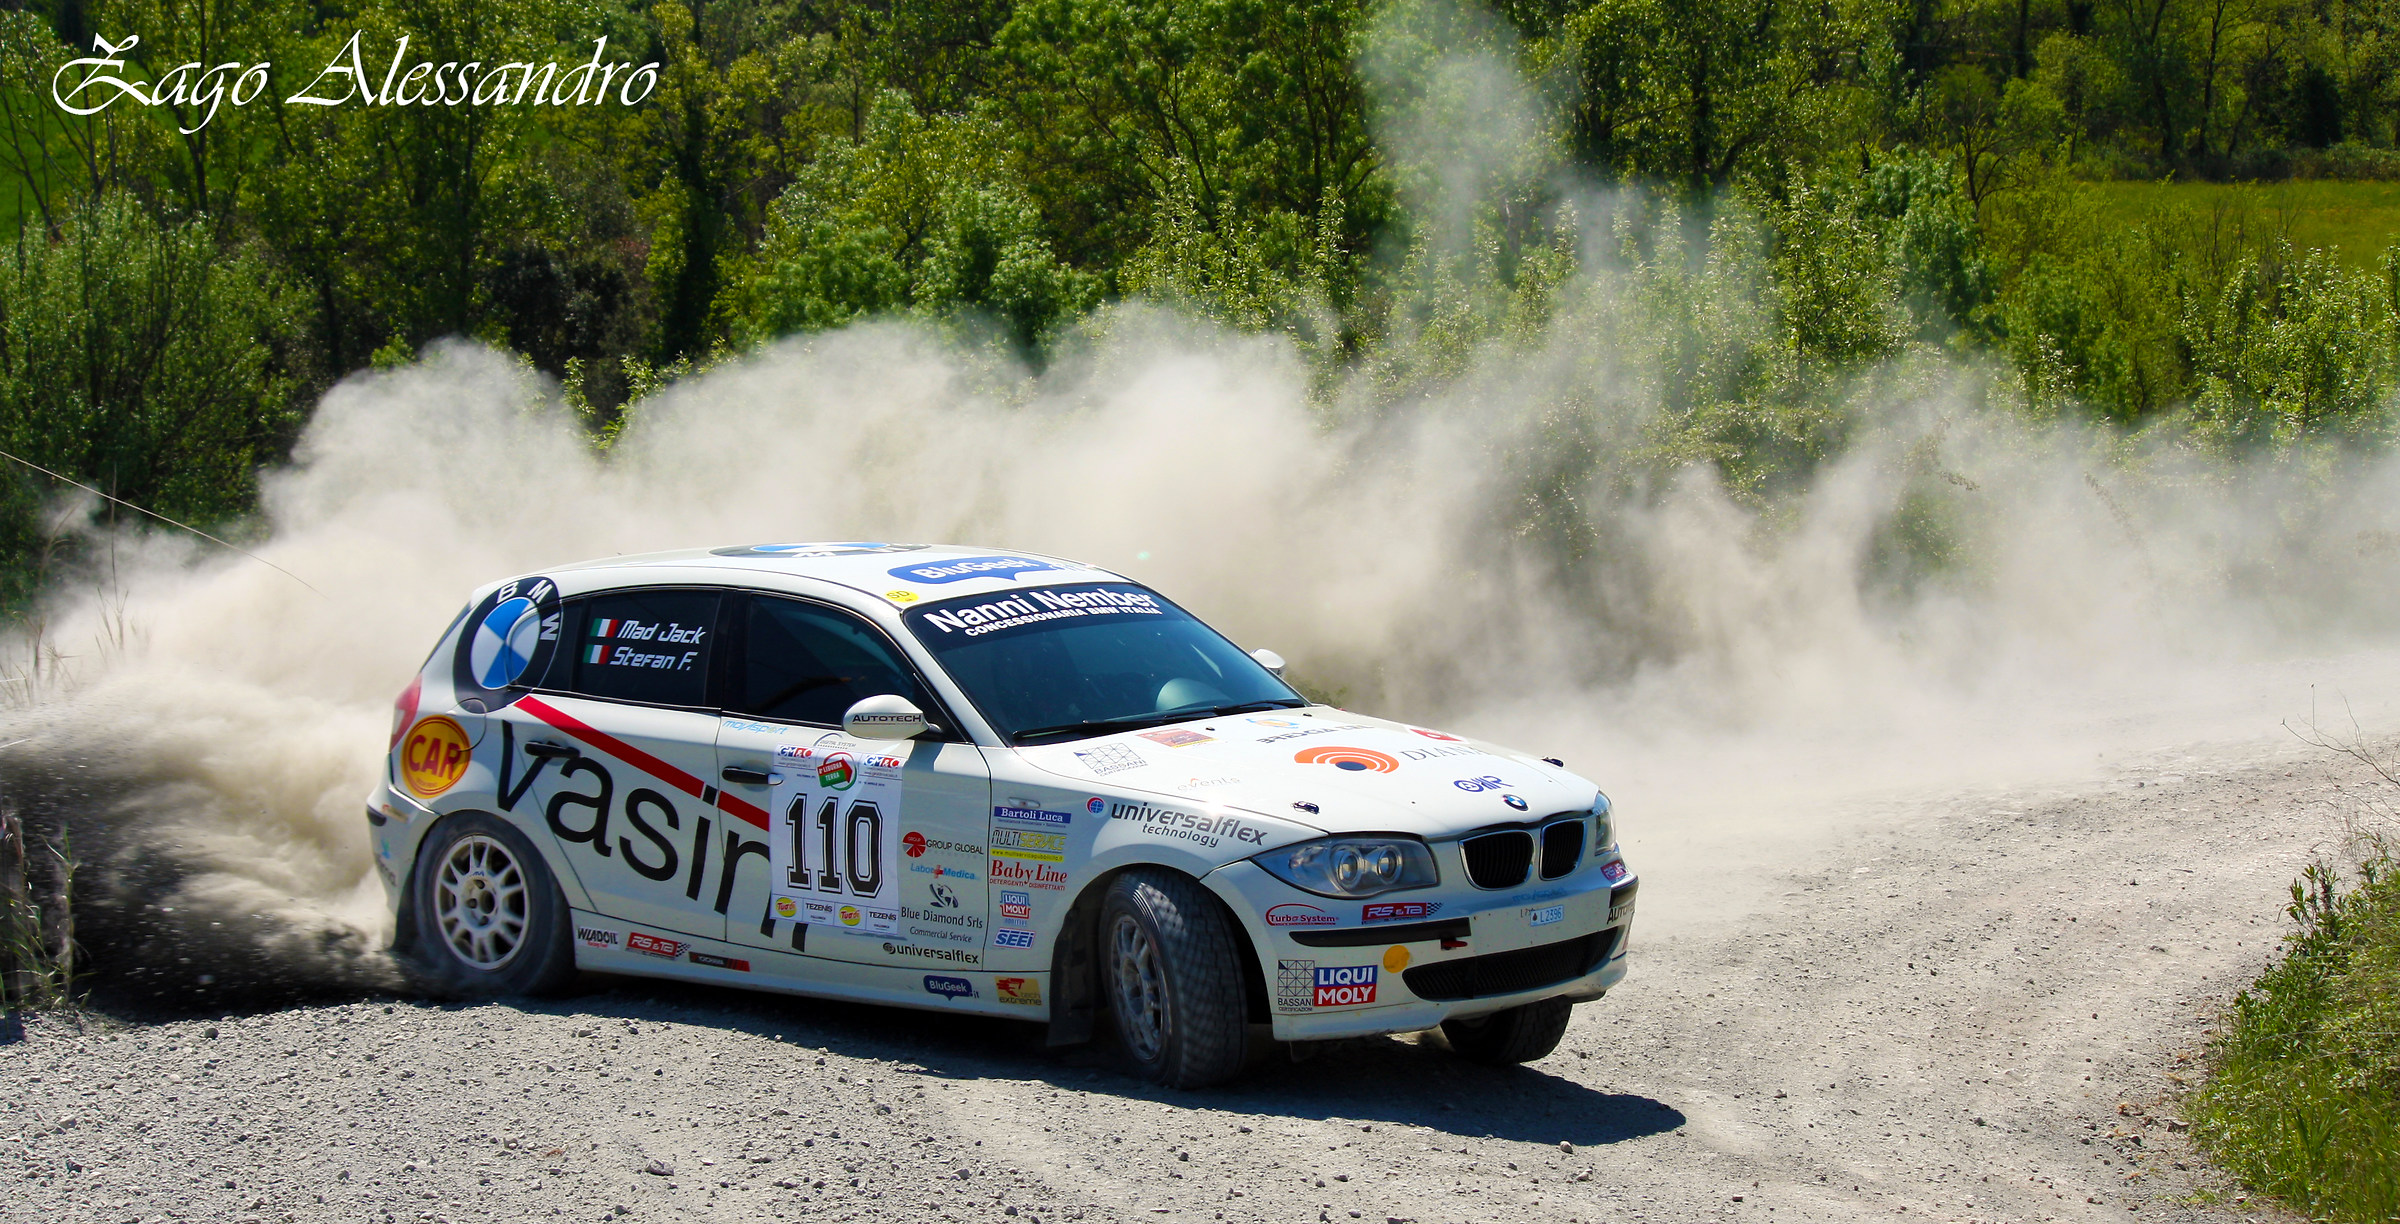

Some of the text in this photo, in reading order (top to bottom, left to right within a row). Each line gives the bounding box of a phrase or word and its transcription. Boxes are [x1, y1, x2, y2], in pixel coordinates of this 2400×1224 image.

[497, 579, 560, 641] BMW
[923, 587, 1160, 633] Nanni Nember
[964, 605, 1163, 637] CONCESSIONARIA BMW ITALIA
[617, 620, 707, 645] Mad Jack
[610, 647, 698, 671] Stefan F.
[852, 714, 922, 723] AUTOTECH
[409, 735, 462, 780] CAR
[1094, 758, 1147, 775] BASSANI
[1177, 776, 1241, 792] events
[1001, 808, 1063, 823] Bartoli Luca
[1111, 802, 1269, 846] universalflex
[498, 719, 808, 953] vasin
[1142, 823, 1220, 848] technology
[786, 793, 883, 899] 110
[926, 839, 952, 850] GROUP
[955, 843, 984, 855] GLOBAL
[943, 867, 975, 879] Medica
[991, 859, 1067, 884] Baby Line
[1004, 894, 1026, 905] LIQUI
[1004, 904, 1027, 915] MOLY
[901, 907, 983, 929] Blue Diamond Srls
[1300, 914, 1336, 924] System
[910, 926, 972, 943] Commercial Service
[897, 943, 979, 964] universalflex
[1318, 967, 1373, 985] LIQUI
[1278, 997, 1314, 1006] BASSANI
[1318, 985, 1373, 1005] MOLY
